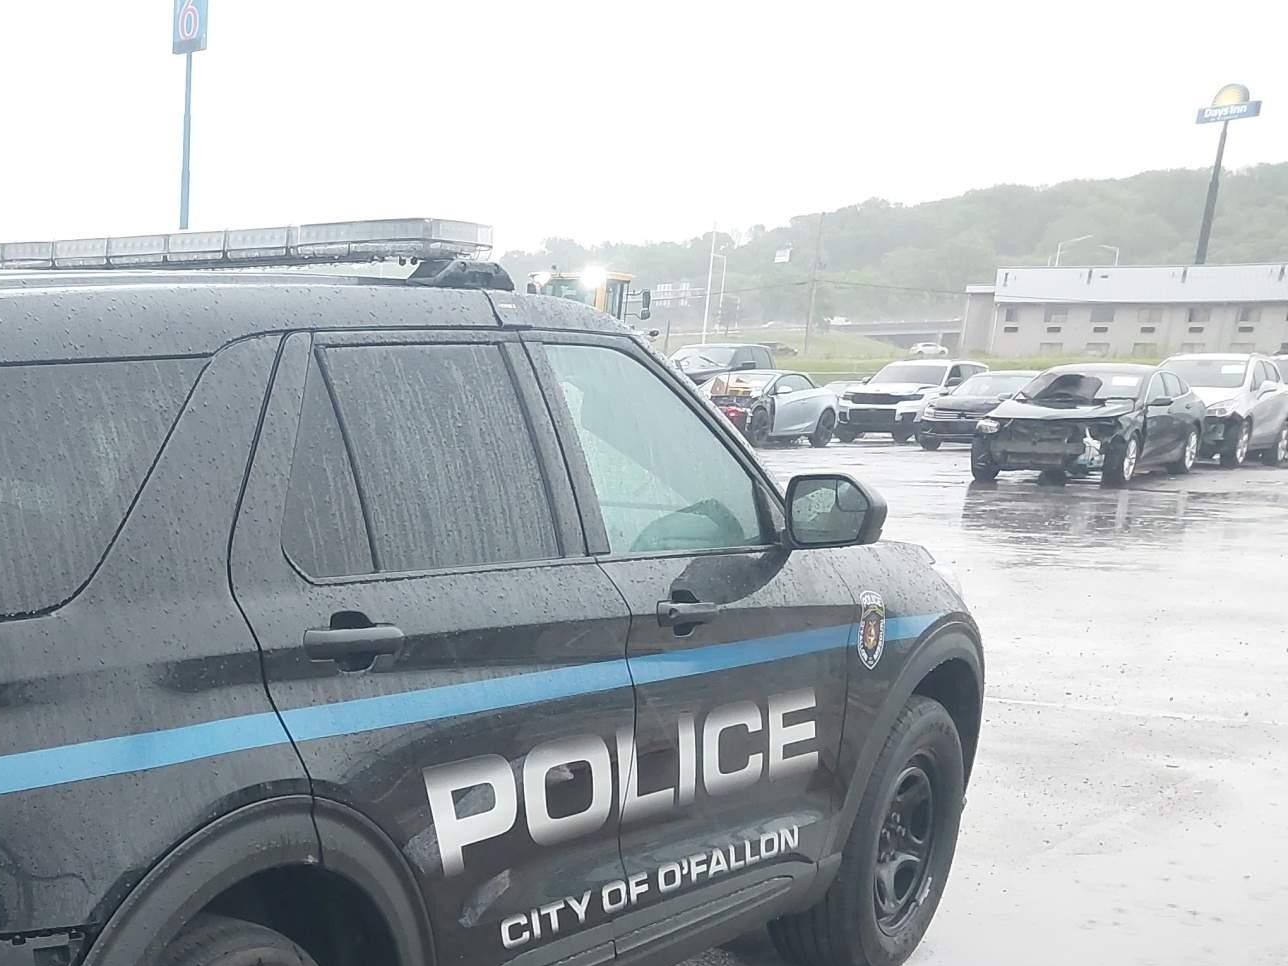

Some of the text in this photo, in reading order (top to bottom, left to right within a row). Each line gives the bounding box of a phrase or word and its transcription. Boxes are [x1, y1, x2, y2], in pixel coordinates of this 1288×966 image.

[178, 0, 199, 40] 6
[423, 688, 819, 877] POLICE
[500, 825, 800, 949] CITY OF O'FALLON
